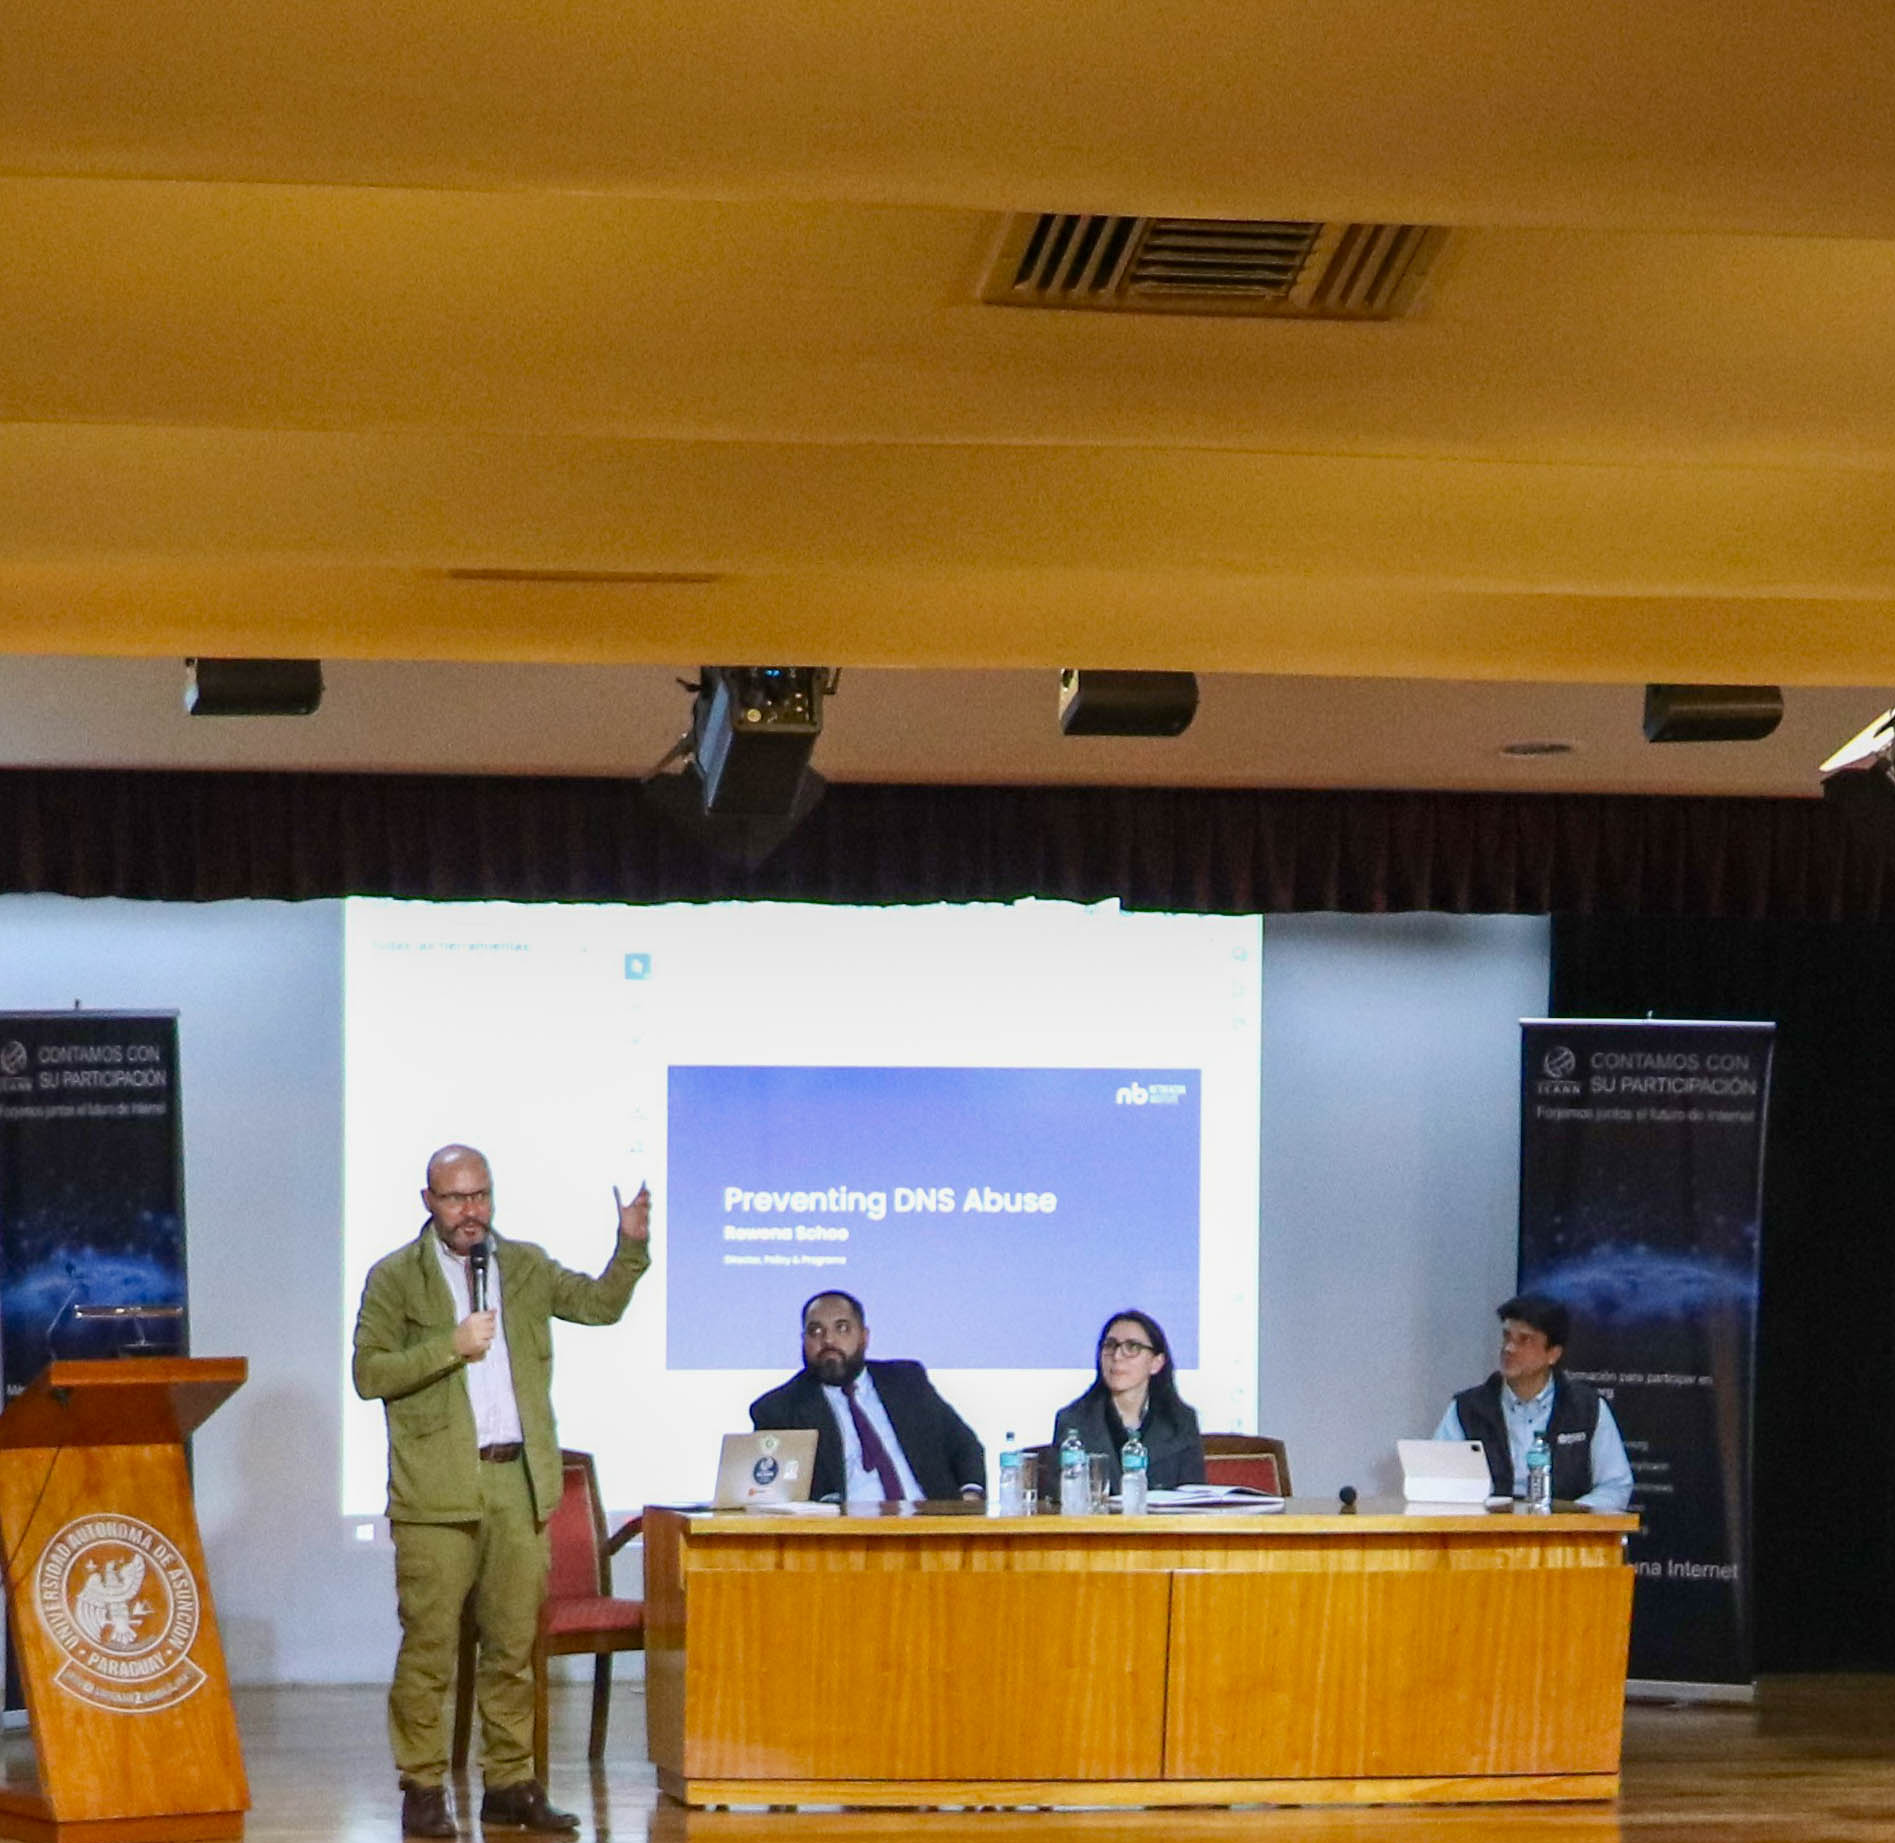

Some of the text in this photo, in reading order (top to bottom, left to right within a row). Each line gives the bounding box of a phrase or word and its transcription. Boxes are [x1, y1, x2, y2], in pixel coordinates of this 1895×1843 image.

[37, 1045, 161, 1064] CONTAMOS CON
[1589, 1051, 1750, 1071] CONTAMOS CON
[38, 1070, 59, 1089] SU
[1590, 1075, 1758, 1096] SU PARTICIPACIÓN
[722, 1185, 1059, 1222] Preventing DNS Abuse
[1668, 1559, 1739, 1580] Internet
[67, 1521, 154, 1550] AUTONOMA
[153, 1543, 174, 1568] DE
[168, 1568, 194, 1650] ASUNCION
[88, 1651, 168, 1678] PARAGUAY
